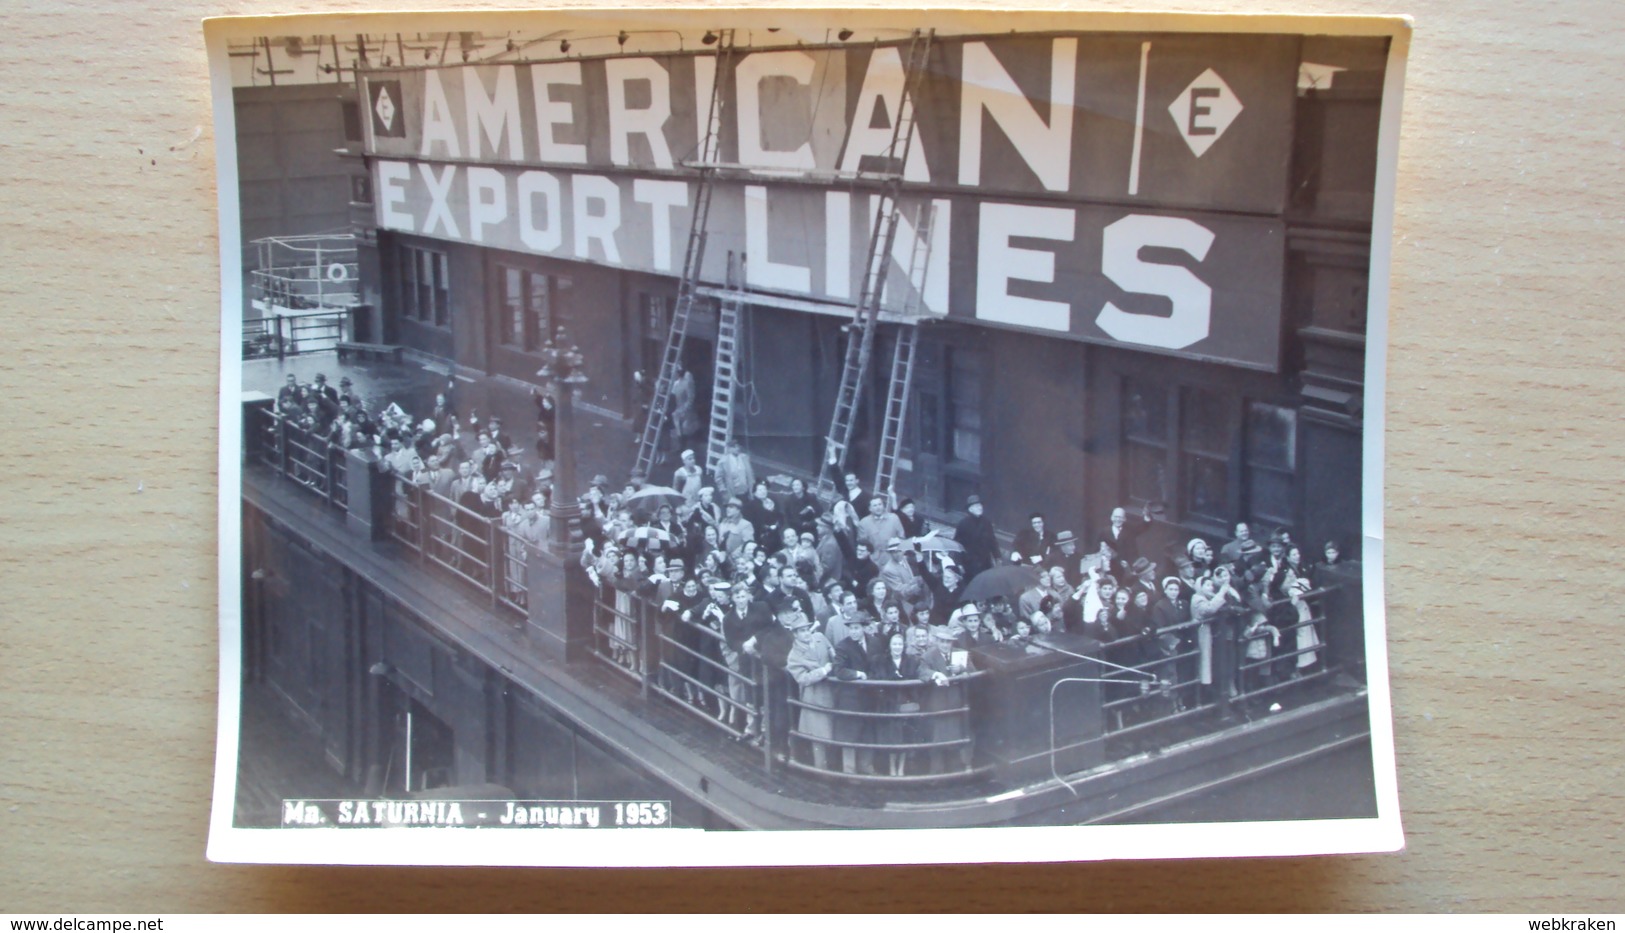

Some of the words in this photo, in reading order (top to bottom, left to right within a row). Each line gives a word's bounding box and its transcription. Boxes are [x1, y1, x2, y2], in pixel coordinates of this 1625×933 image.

[420, 37, 1077, 192] AMERICAN
[1187, 87, 1220, 136] E
[378, 160, 688, 271] EXPORT
[744, 186, 1215, 350] LINES
